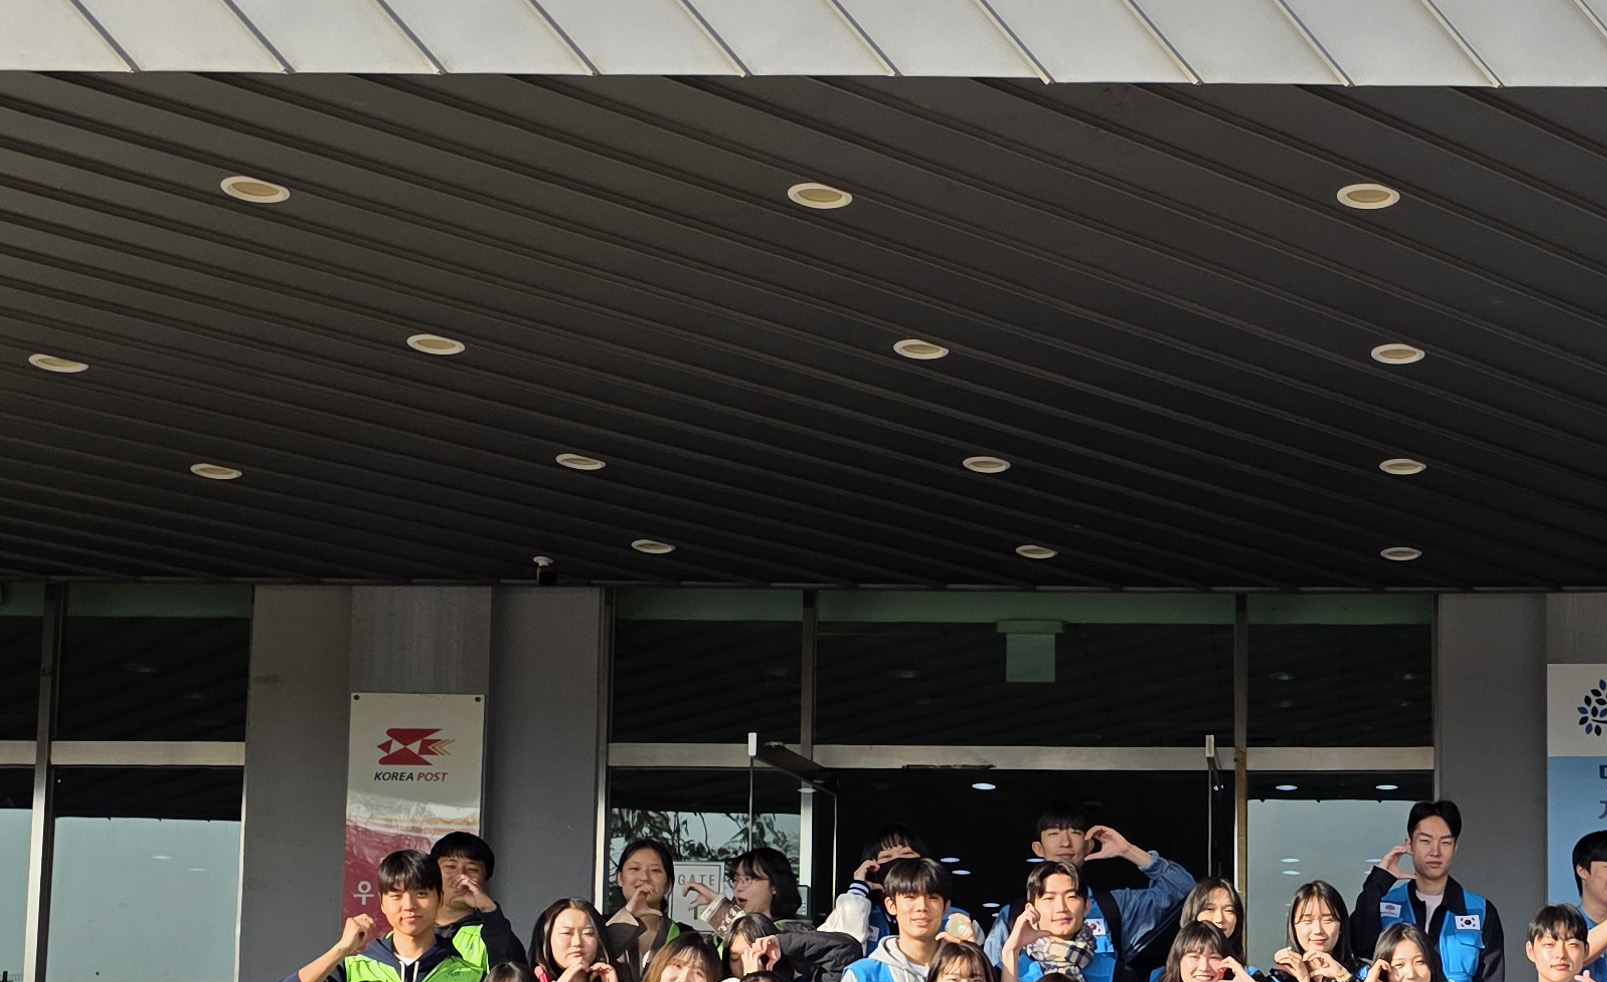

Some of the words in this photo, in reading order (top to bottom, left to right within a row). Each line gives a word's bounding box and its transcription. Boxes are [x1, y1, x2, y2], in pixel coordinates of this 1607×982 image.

[374, 771, 414, 782] KOREA
[417, 772, 448, 782] POST
[677, 873, 716, 887] GATE
